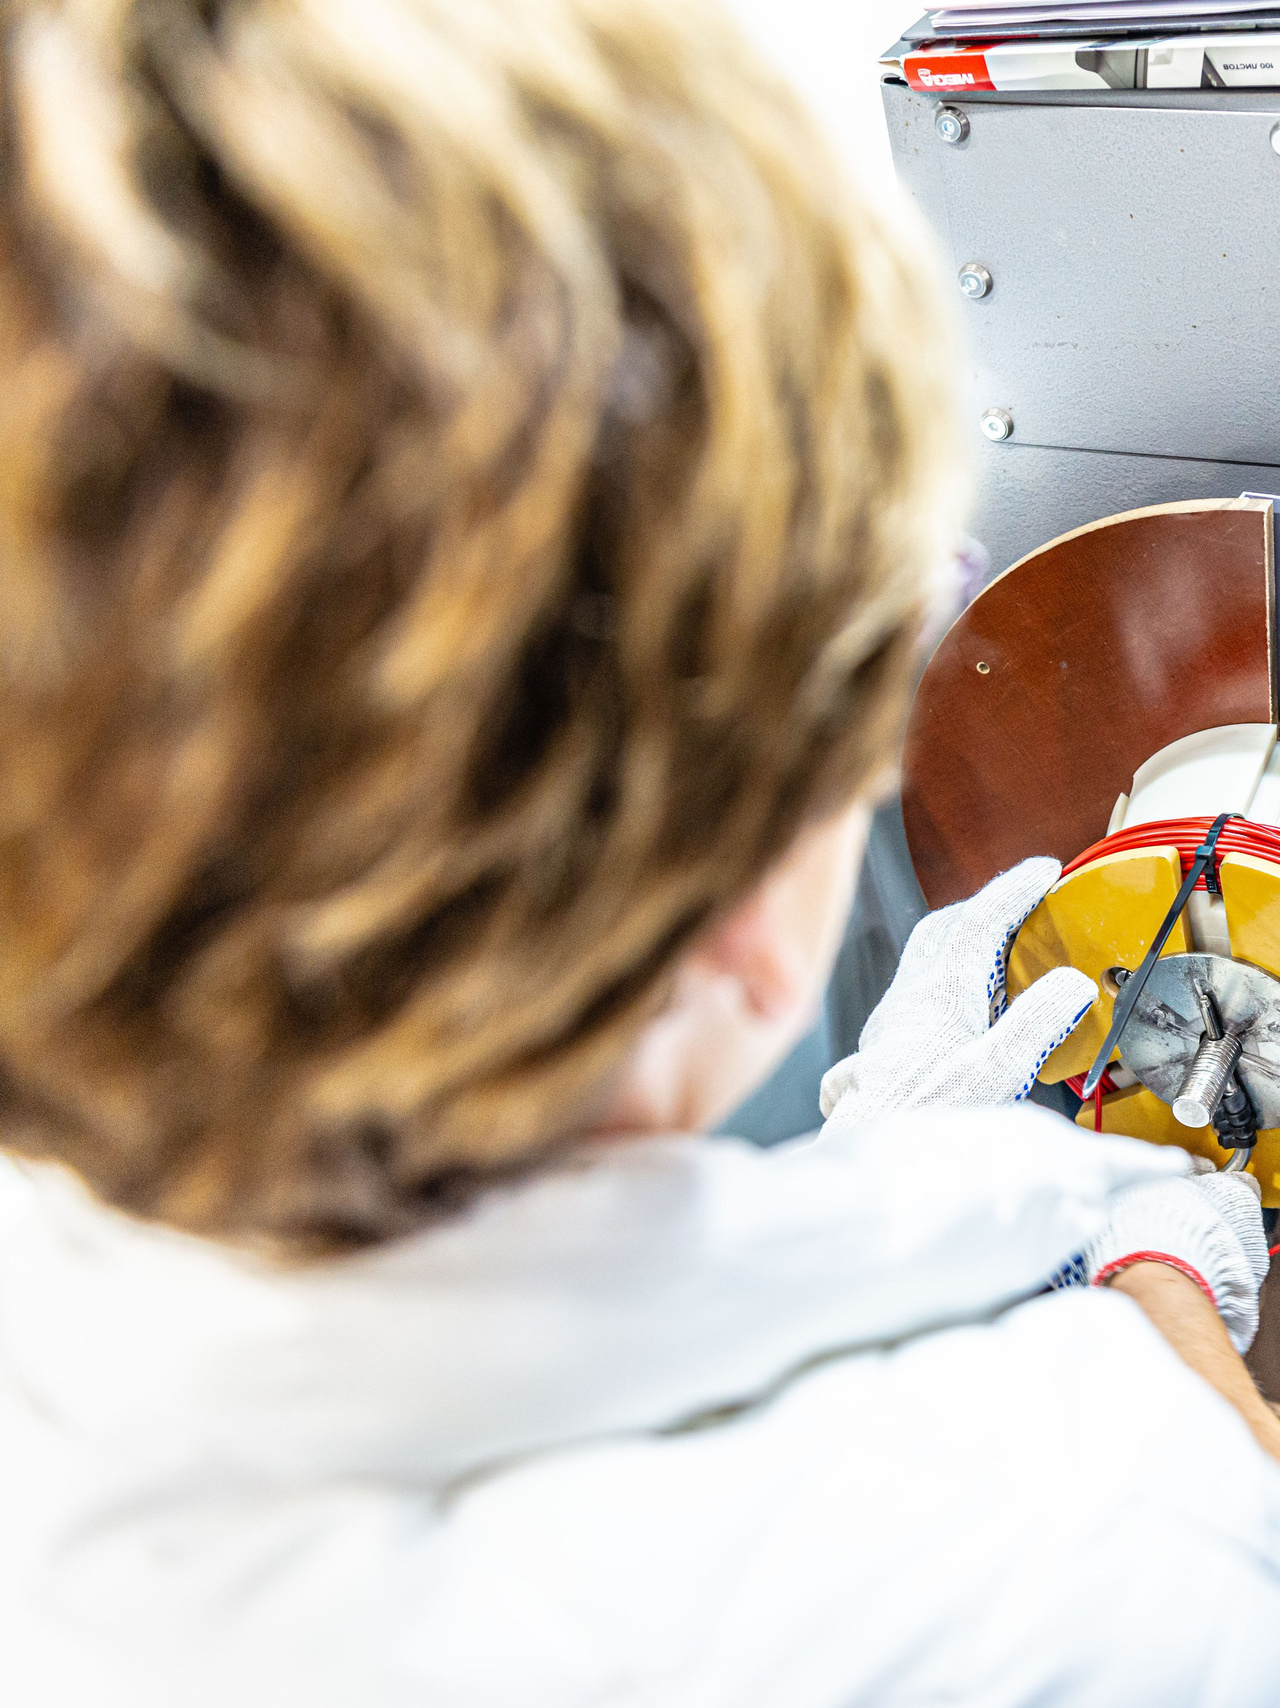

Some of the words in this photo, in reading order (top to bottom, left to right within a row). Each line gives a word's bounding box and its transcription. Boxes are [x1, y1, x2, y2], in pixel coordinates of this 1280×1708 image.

[1222, 62, 1259, 71] ЛИСТОВ
[1259, 62, 1275, 70] 100
[917, 70, 975, 87] MEGA
